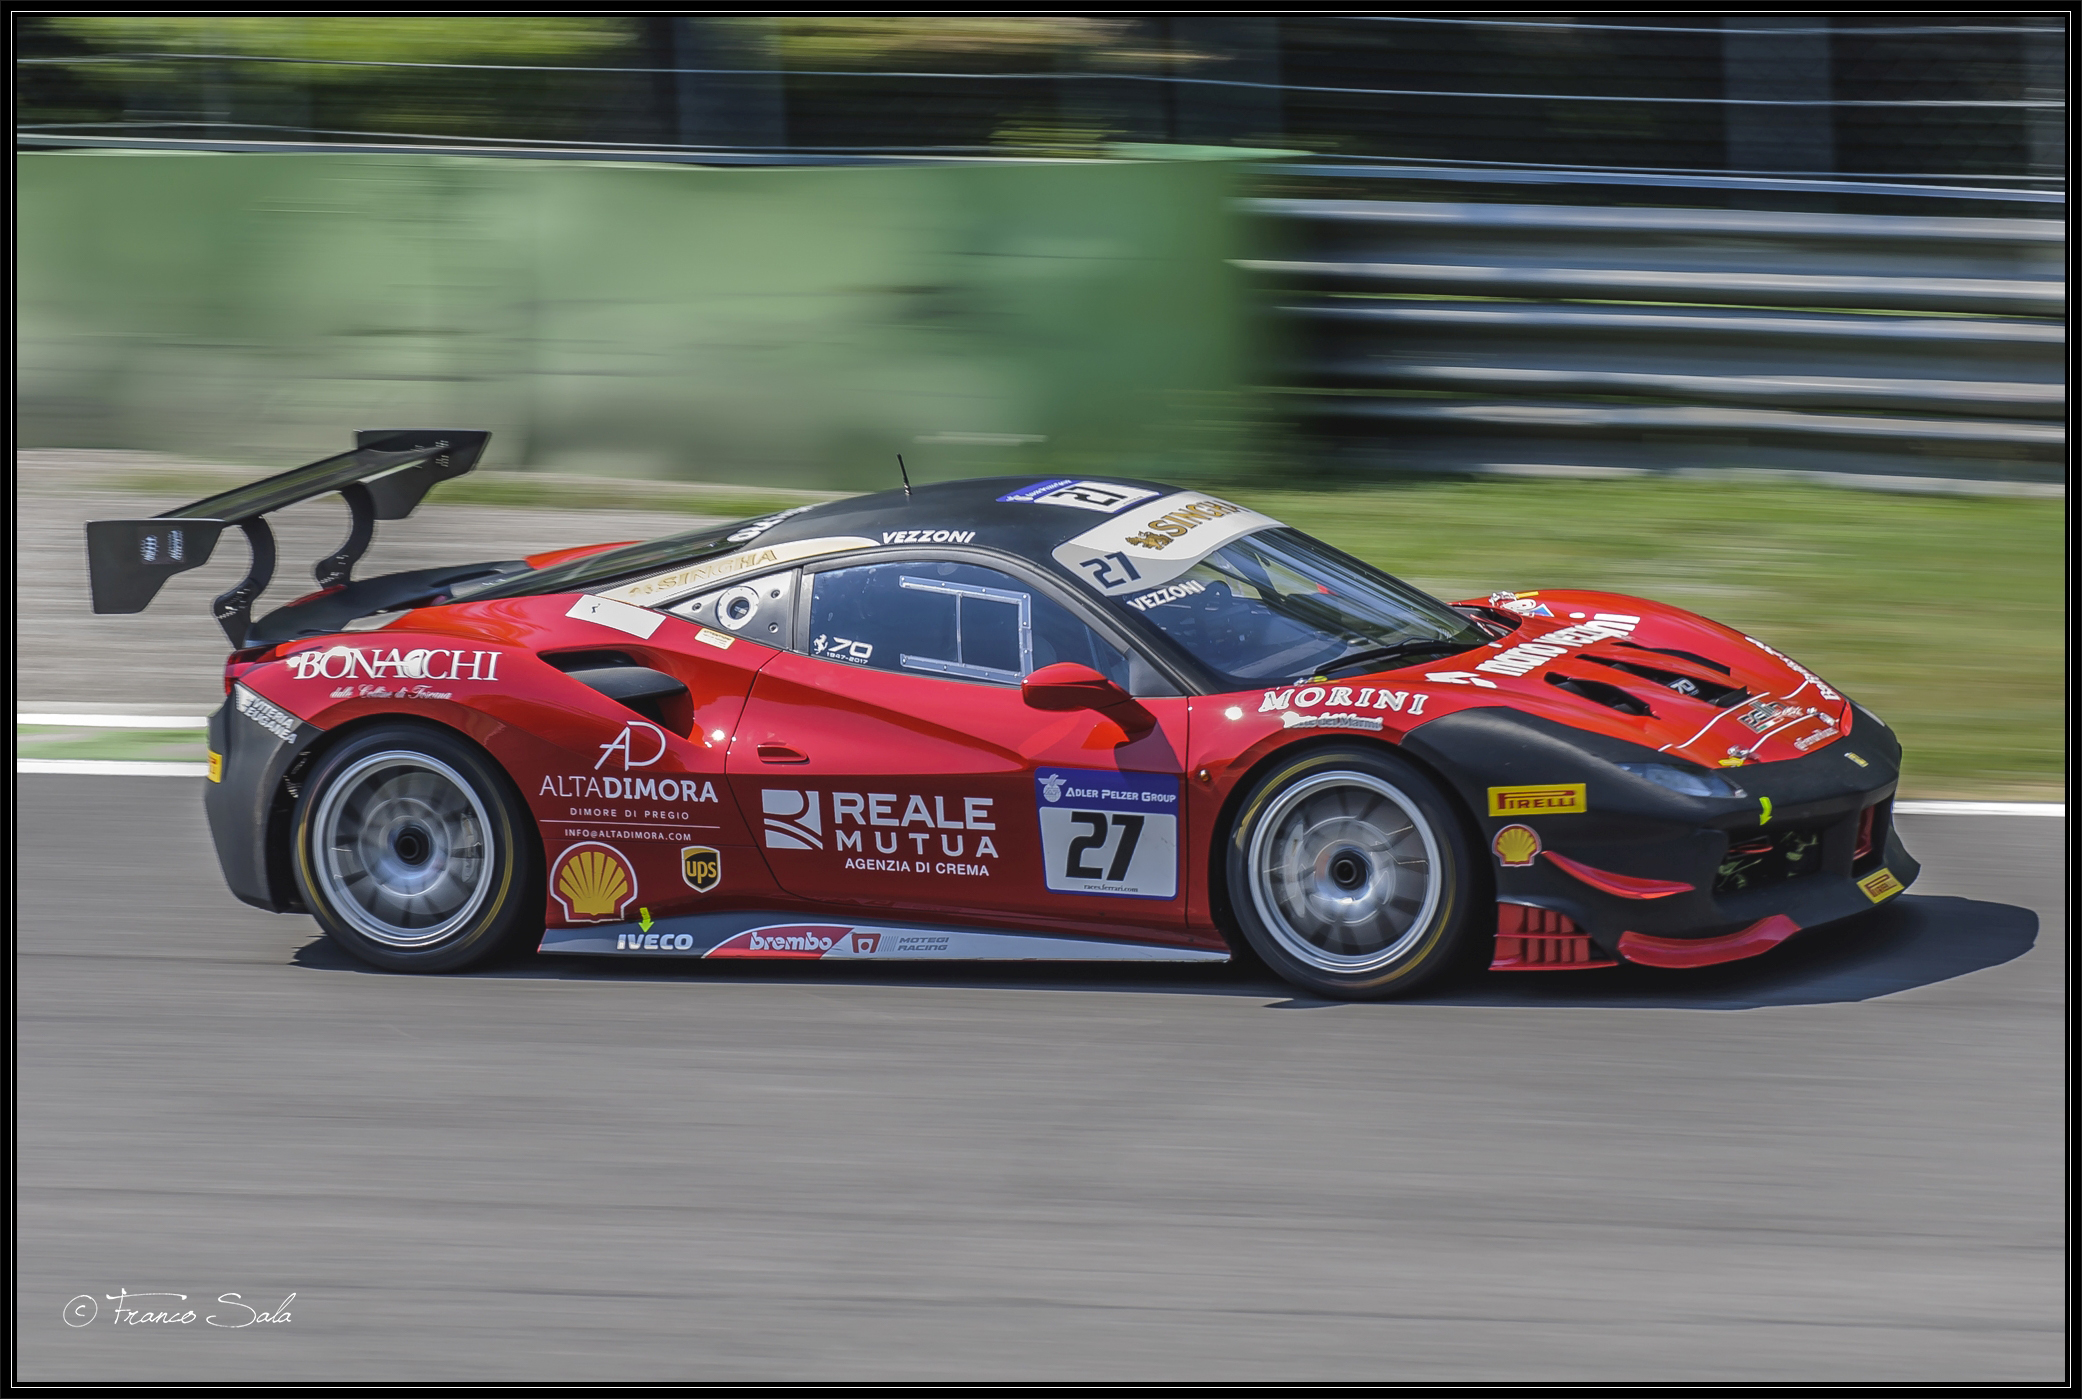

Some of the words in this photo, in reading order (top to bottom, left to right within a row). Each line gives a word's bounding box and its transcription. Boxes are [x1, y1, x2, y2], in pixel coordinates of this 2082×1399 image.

[882, 530, 976, 543] VEZZONI
[657, 549, 778, 592] SINGHA
[1079, 551, 1142, 589] 27
[1126, 580, 1206, 612] VEZZONI
[826, 651, 869, 665] 1947-2017
[828, 637, 873, 659] 70
[293, 646, 503, 681] BONACCHI
[1258, 686, 1429, 715] MORINI
[539, 775, 718, 803] ALTADIMORA
[1065, 787, 1099, 798] ADLER
[1101, 789, 1139, 800] PELZER
[1141, 792, 1177, 803] GROUP
[1498, 790, 1576, 810] PIRELLI
[570, 807, 617, 818] DIMORE
[625, 808, 637, 818] DI
[644, 810, 690, 821] PREGIO
[832, 792, 996, 830] REALE
[564, 829, 692, 841] INFO@ALTADIMORA.COM
[835, 829, 999, 859] MUTUA
[1065, 811, 1145, 881] 27
[686, 860, 717, 884] ups
[845, 858, 911, 873] AGENZIA
[915, 862, 930, 873] DI
[935, 862, 990, 877] CREMA
[1083, 884, 1139, 893] races.ferrari.com
[617, 933, 694, 950] IVECO
[750, 932, 833, 951] brembo
